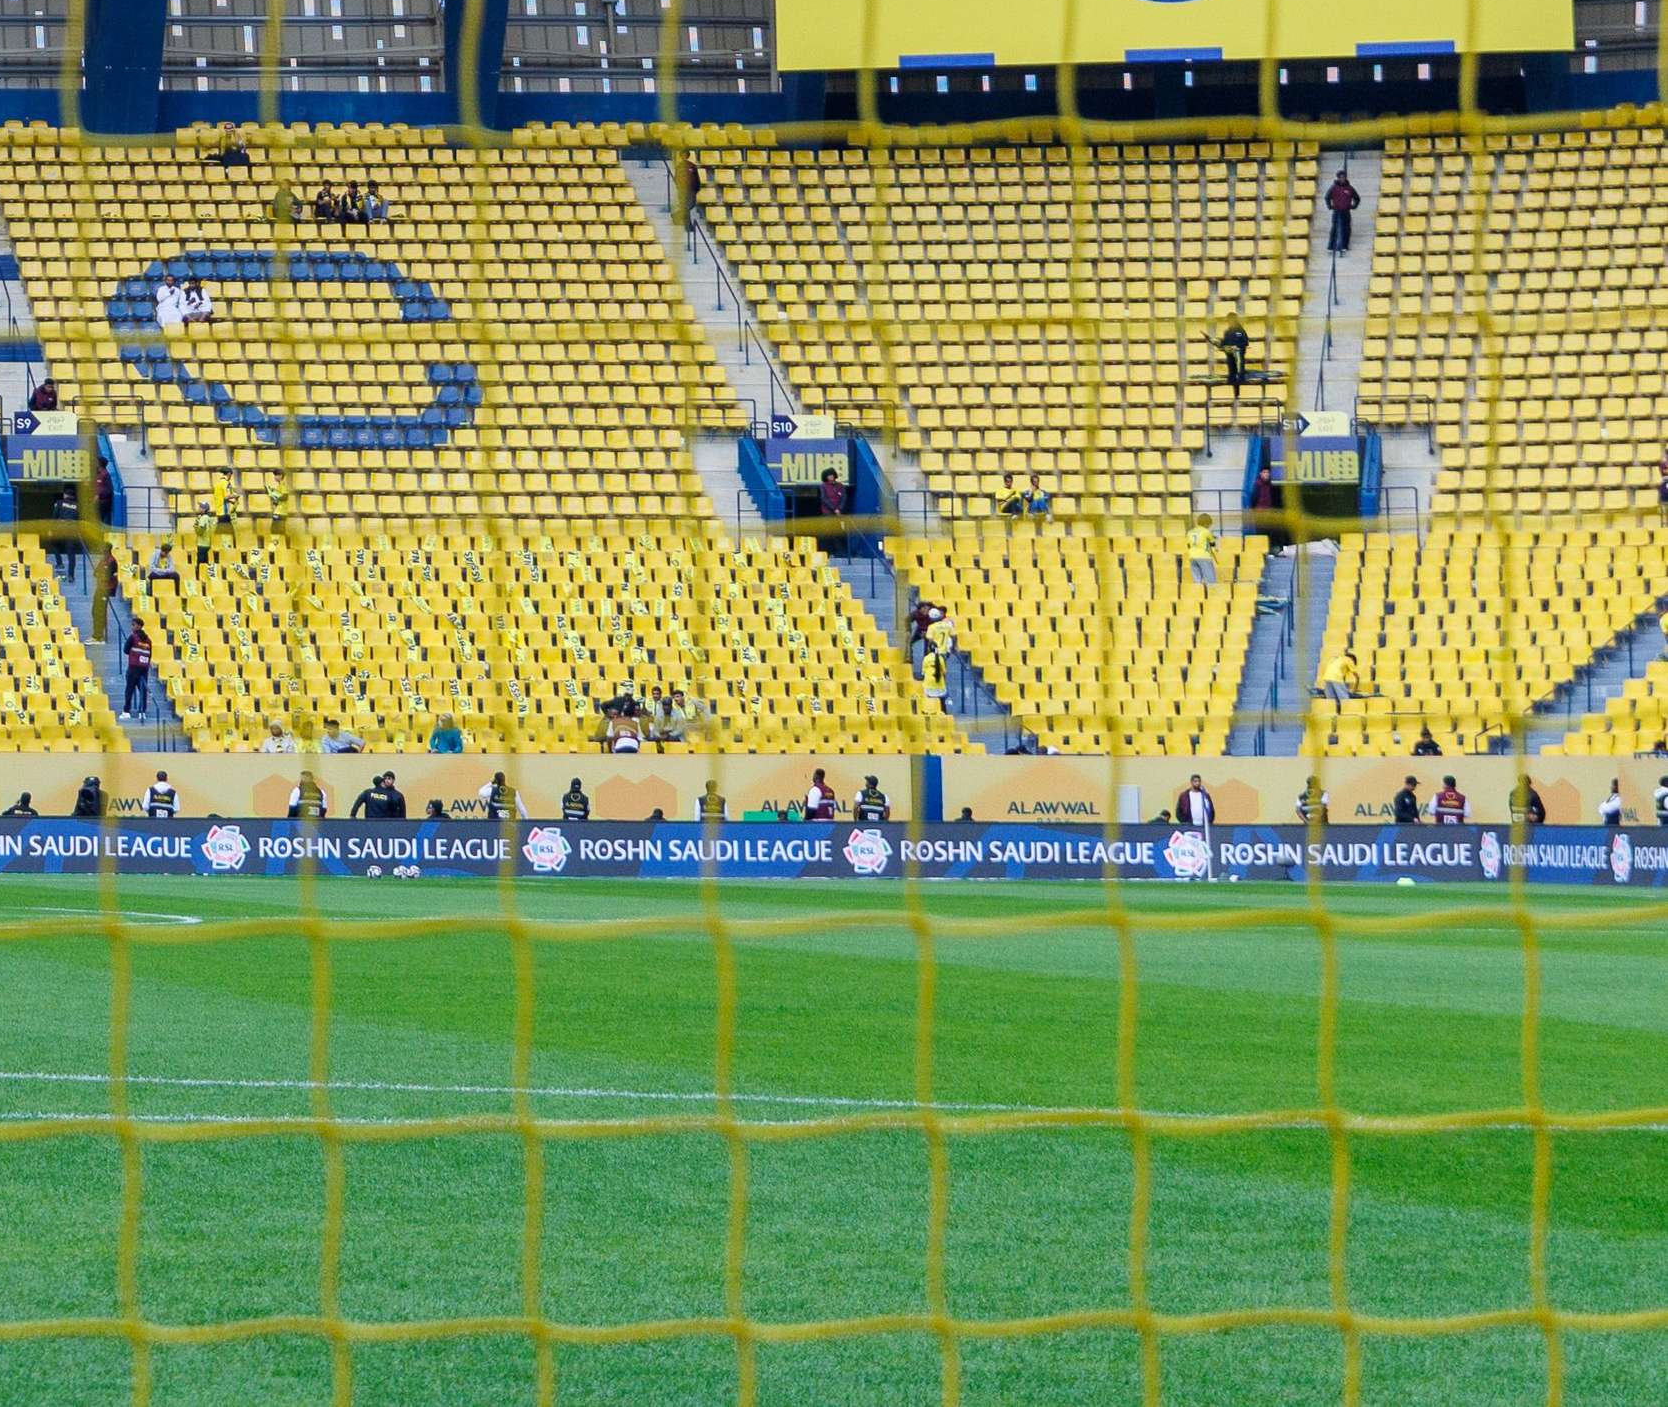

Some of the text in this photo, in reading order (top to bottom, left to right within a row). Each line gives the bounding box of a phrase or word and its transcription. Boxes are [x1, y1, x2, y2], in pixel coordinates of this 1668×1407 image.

[16, 418, 32, 429] S9
[772, 422, 793, 433] S10
[1007, 801, 1101, 816] ALAWWAL
[28, 835, 99, 857] SAUDI
[104, 835, 192, 857] LEAGUE
[258, 837, 513, 860] ROSHN SAUDI LEAGUE
[579, 838, 833, 861] ROSHN SAUDI LEAGUE
[900, 840, 1155, 864] ROSHN SAUDI LEAGUE
[1220, 842, 1303, 864] ROSHN
[1307, 843, 1379, 865] SAUDI
[1383, 844, 1473, 866] LEAGUE
[1503, 844, 1539, 866] ROSHN
[1539, 845, 1569, 867] SAUDI
[1570, 845, 1609, 868] LEAGUE
